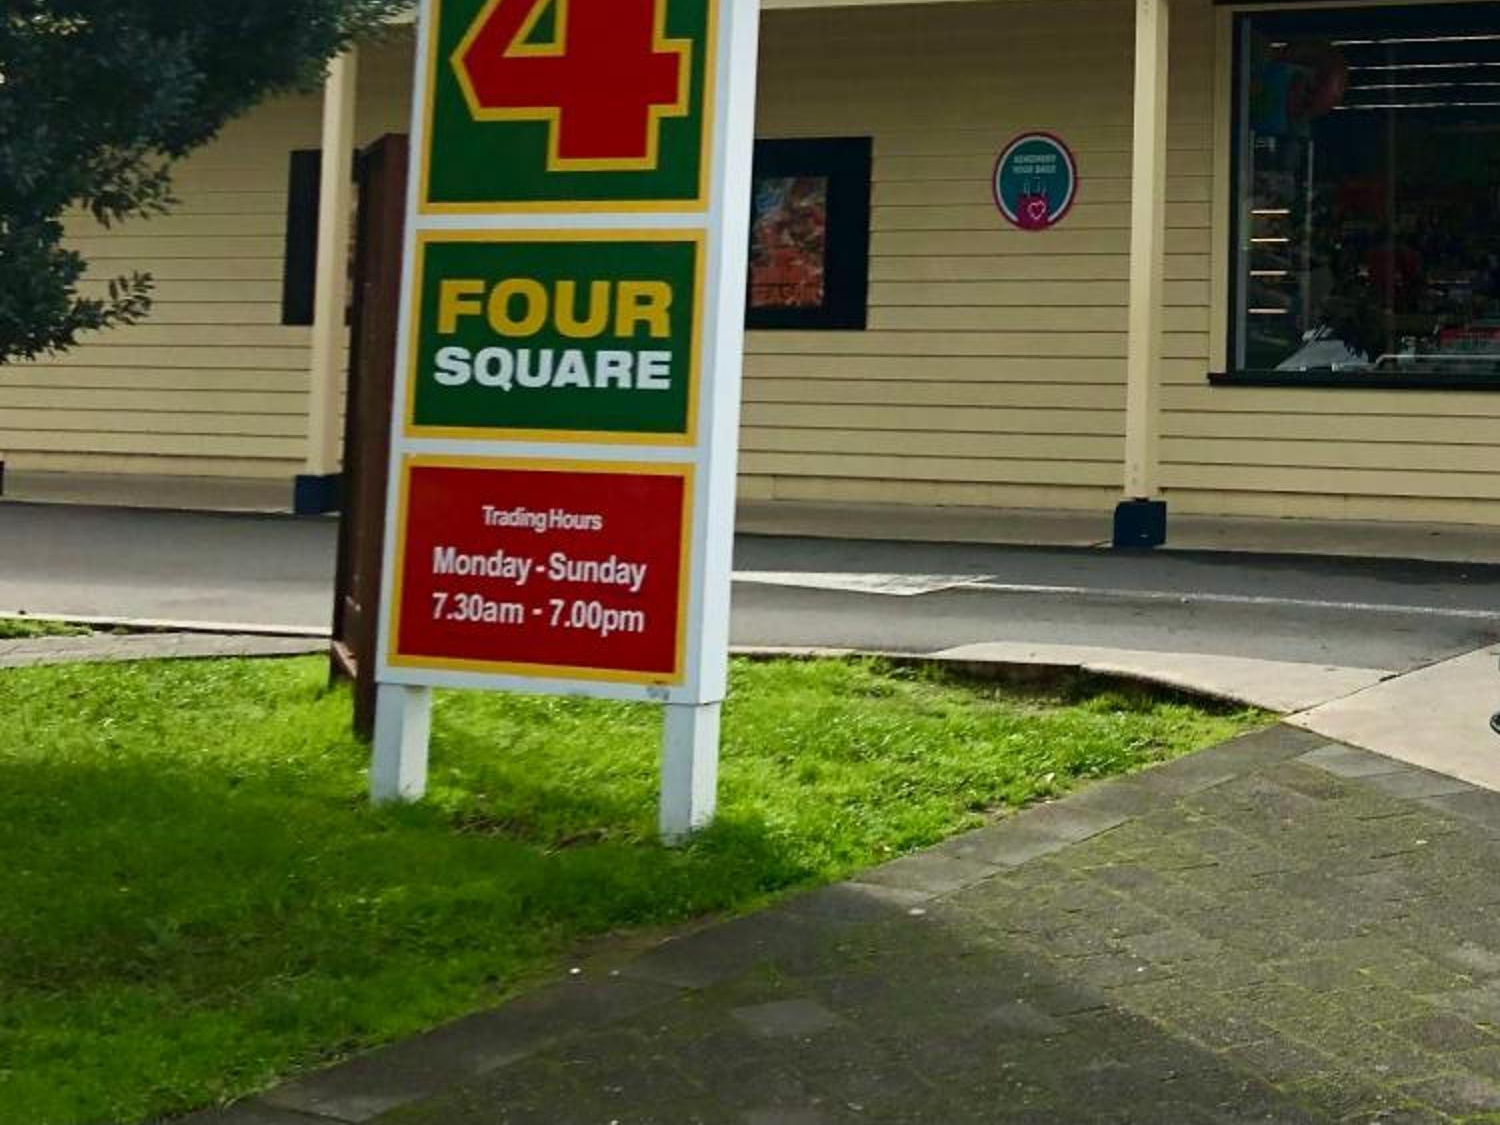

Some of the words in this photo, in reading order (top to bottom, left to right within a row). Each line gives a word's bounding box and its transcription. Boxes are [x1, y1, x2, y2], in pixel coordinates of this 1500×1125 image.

[437, 278, 672, 340] FOUR
[432, 346, 672, 392] SQUARE
[481, 505, 547, 533] Trading
[549, 509, 603, 530] Hours
[432, 546, 532, 586] Monday
[547, 552, 648, 592] Sunday
[431, 592, 524, 625] 7.30am
[548, 599, 645, 637] 7.00pm
